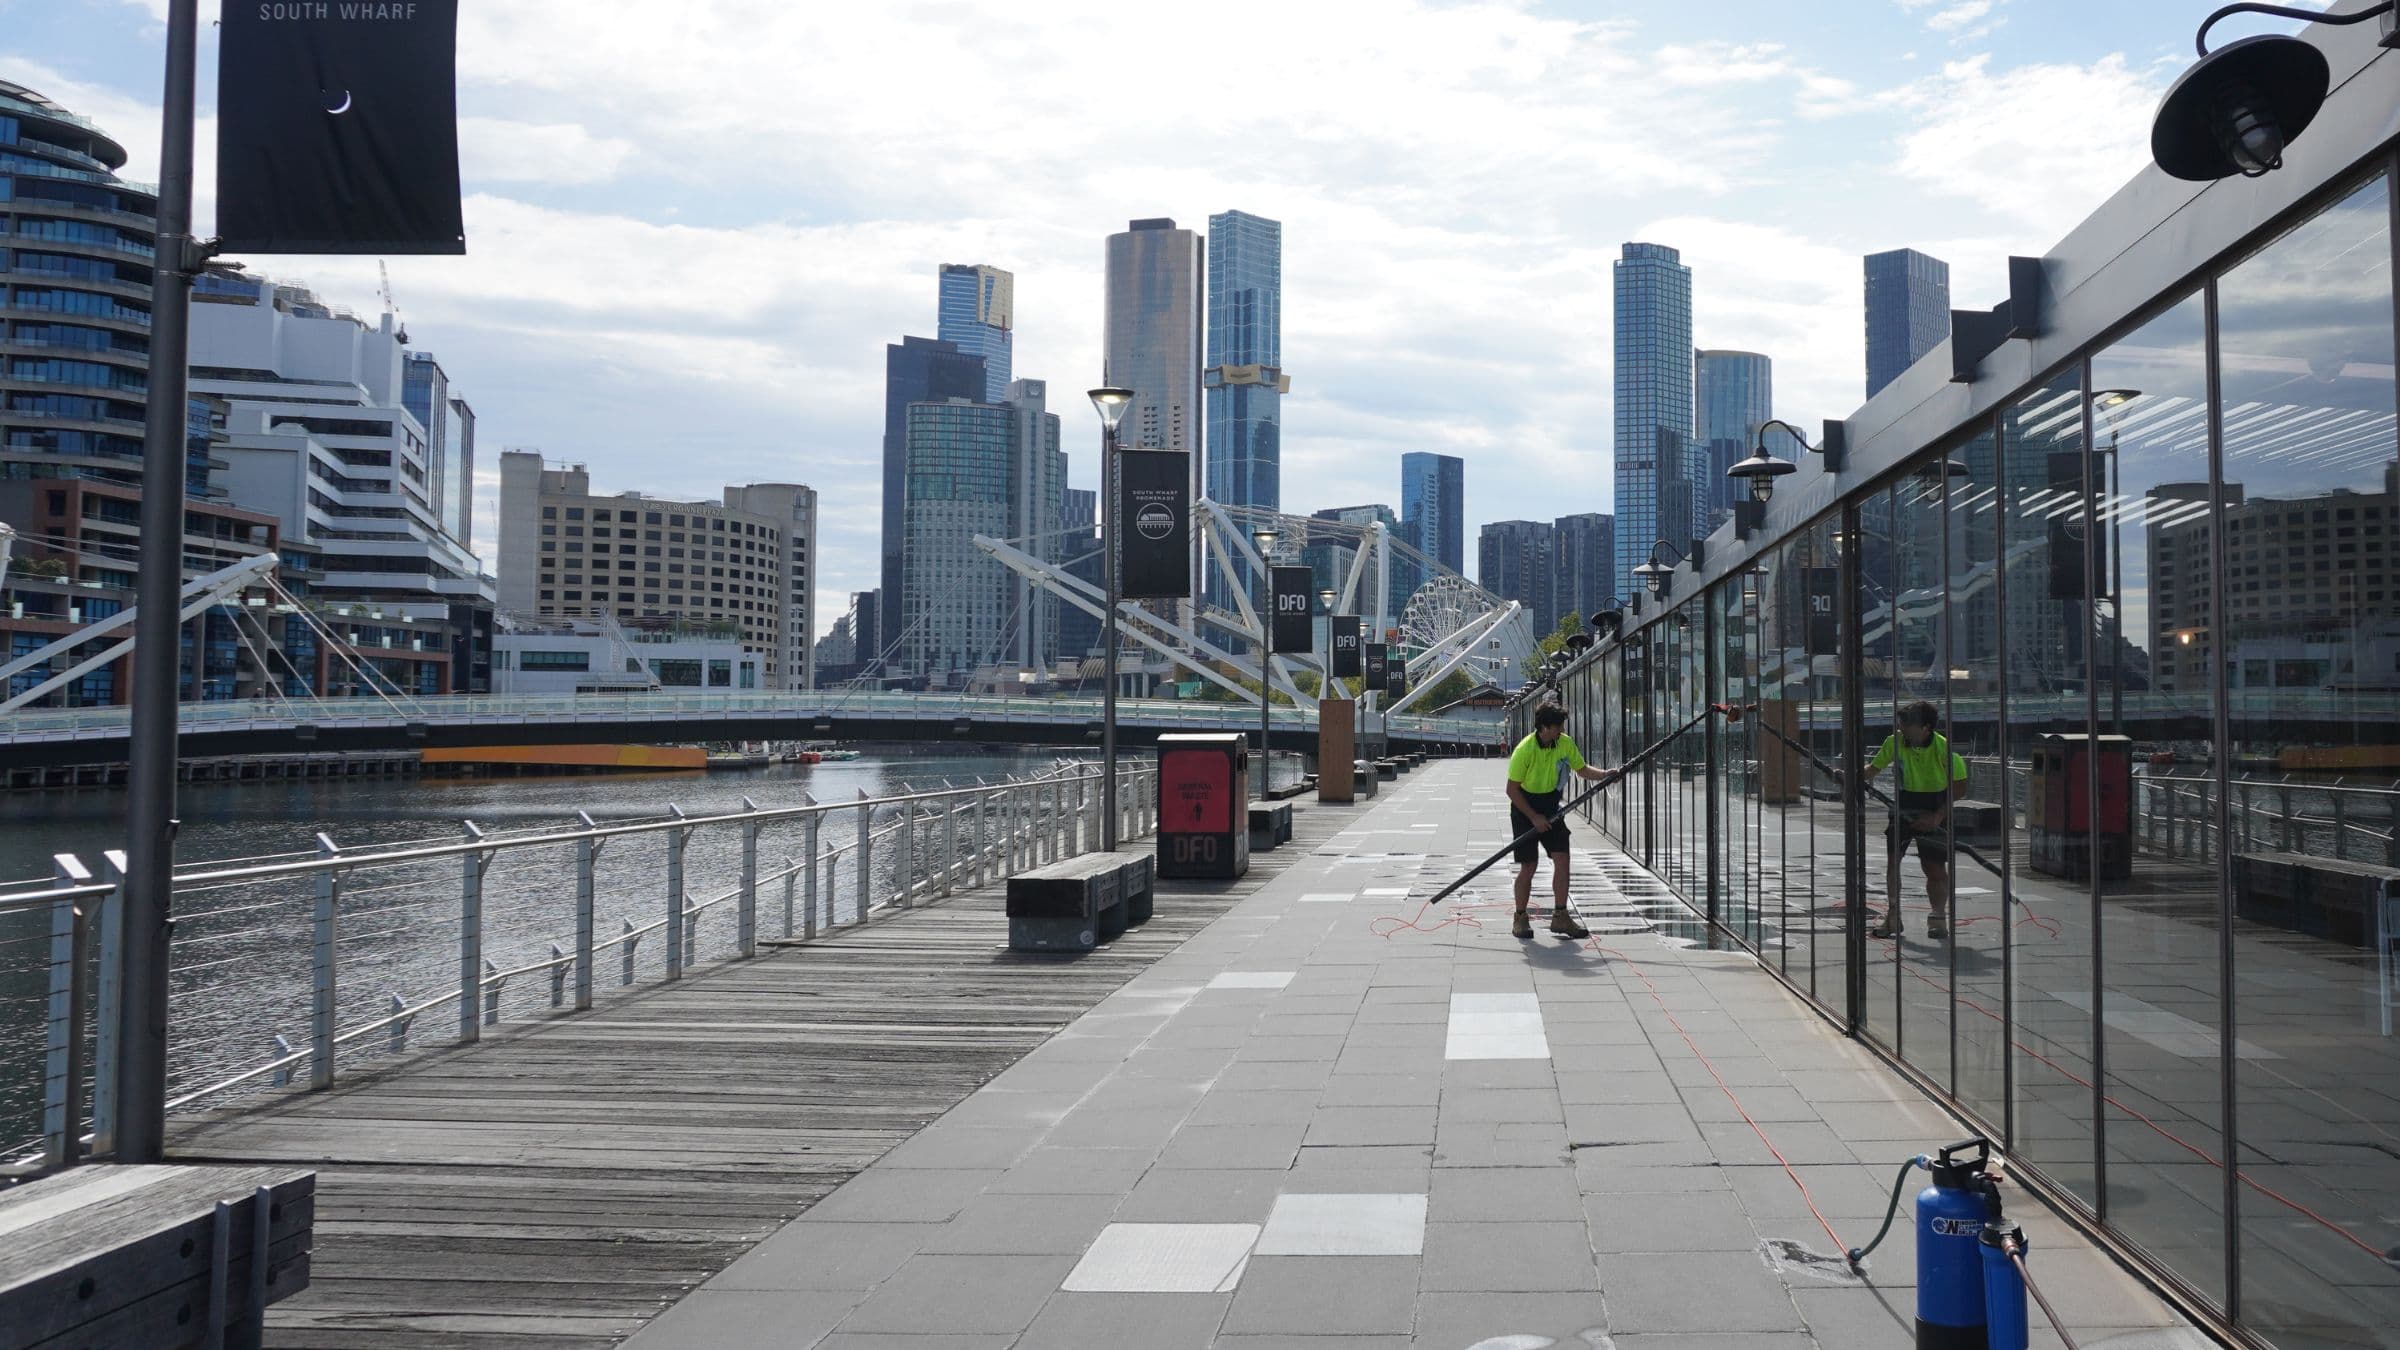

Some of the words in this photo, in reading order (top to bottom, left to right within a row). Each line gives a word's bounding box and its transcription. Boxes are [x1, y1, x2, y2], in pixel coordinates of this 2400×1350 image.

[259, 3, 328, 21] SOUTH
[339, 3, 417, 20] WHARF
[1279, 594, 1306, 611] DFO
[1337, 635, 1356, 648] DFO
[1390, 671, 1403, 680] DFO
[1174, 836, 1217, 863] DFO
